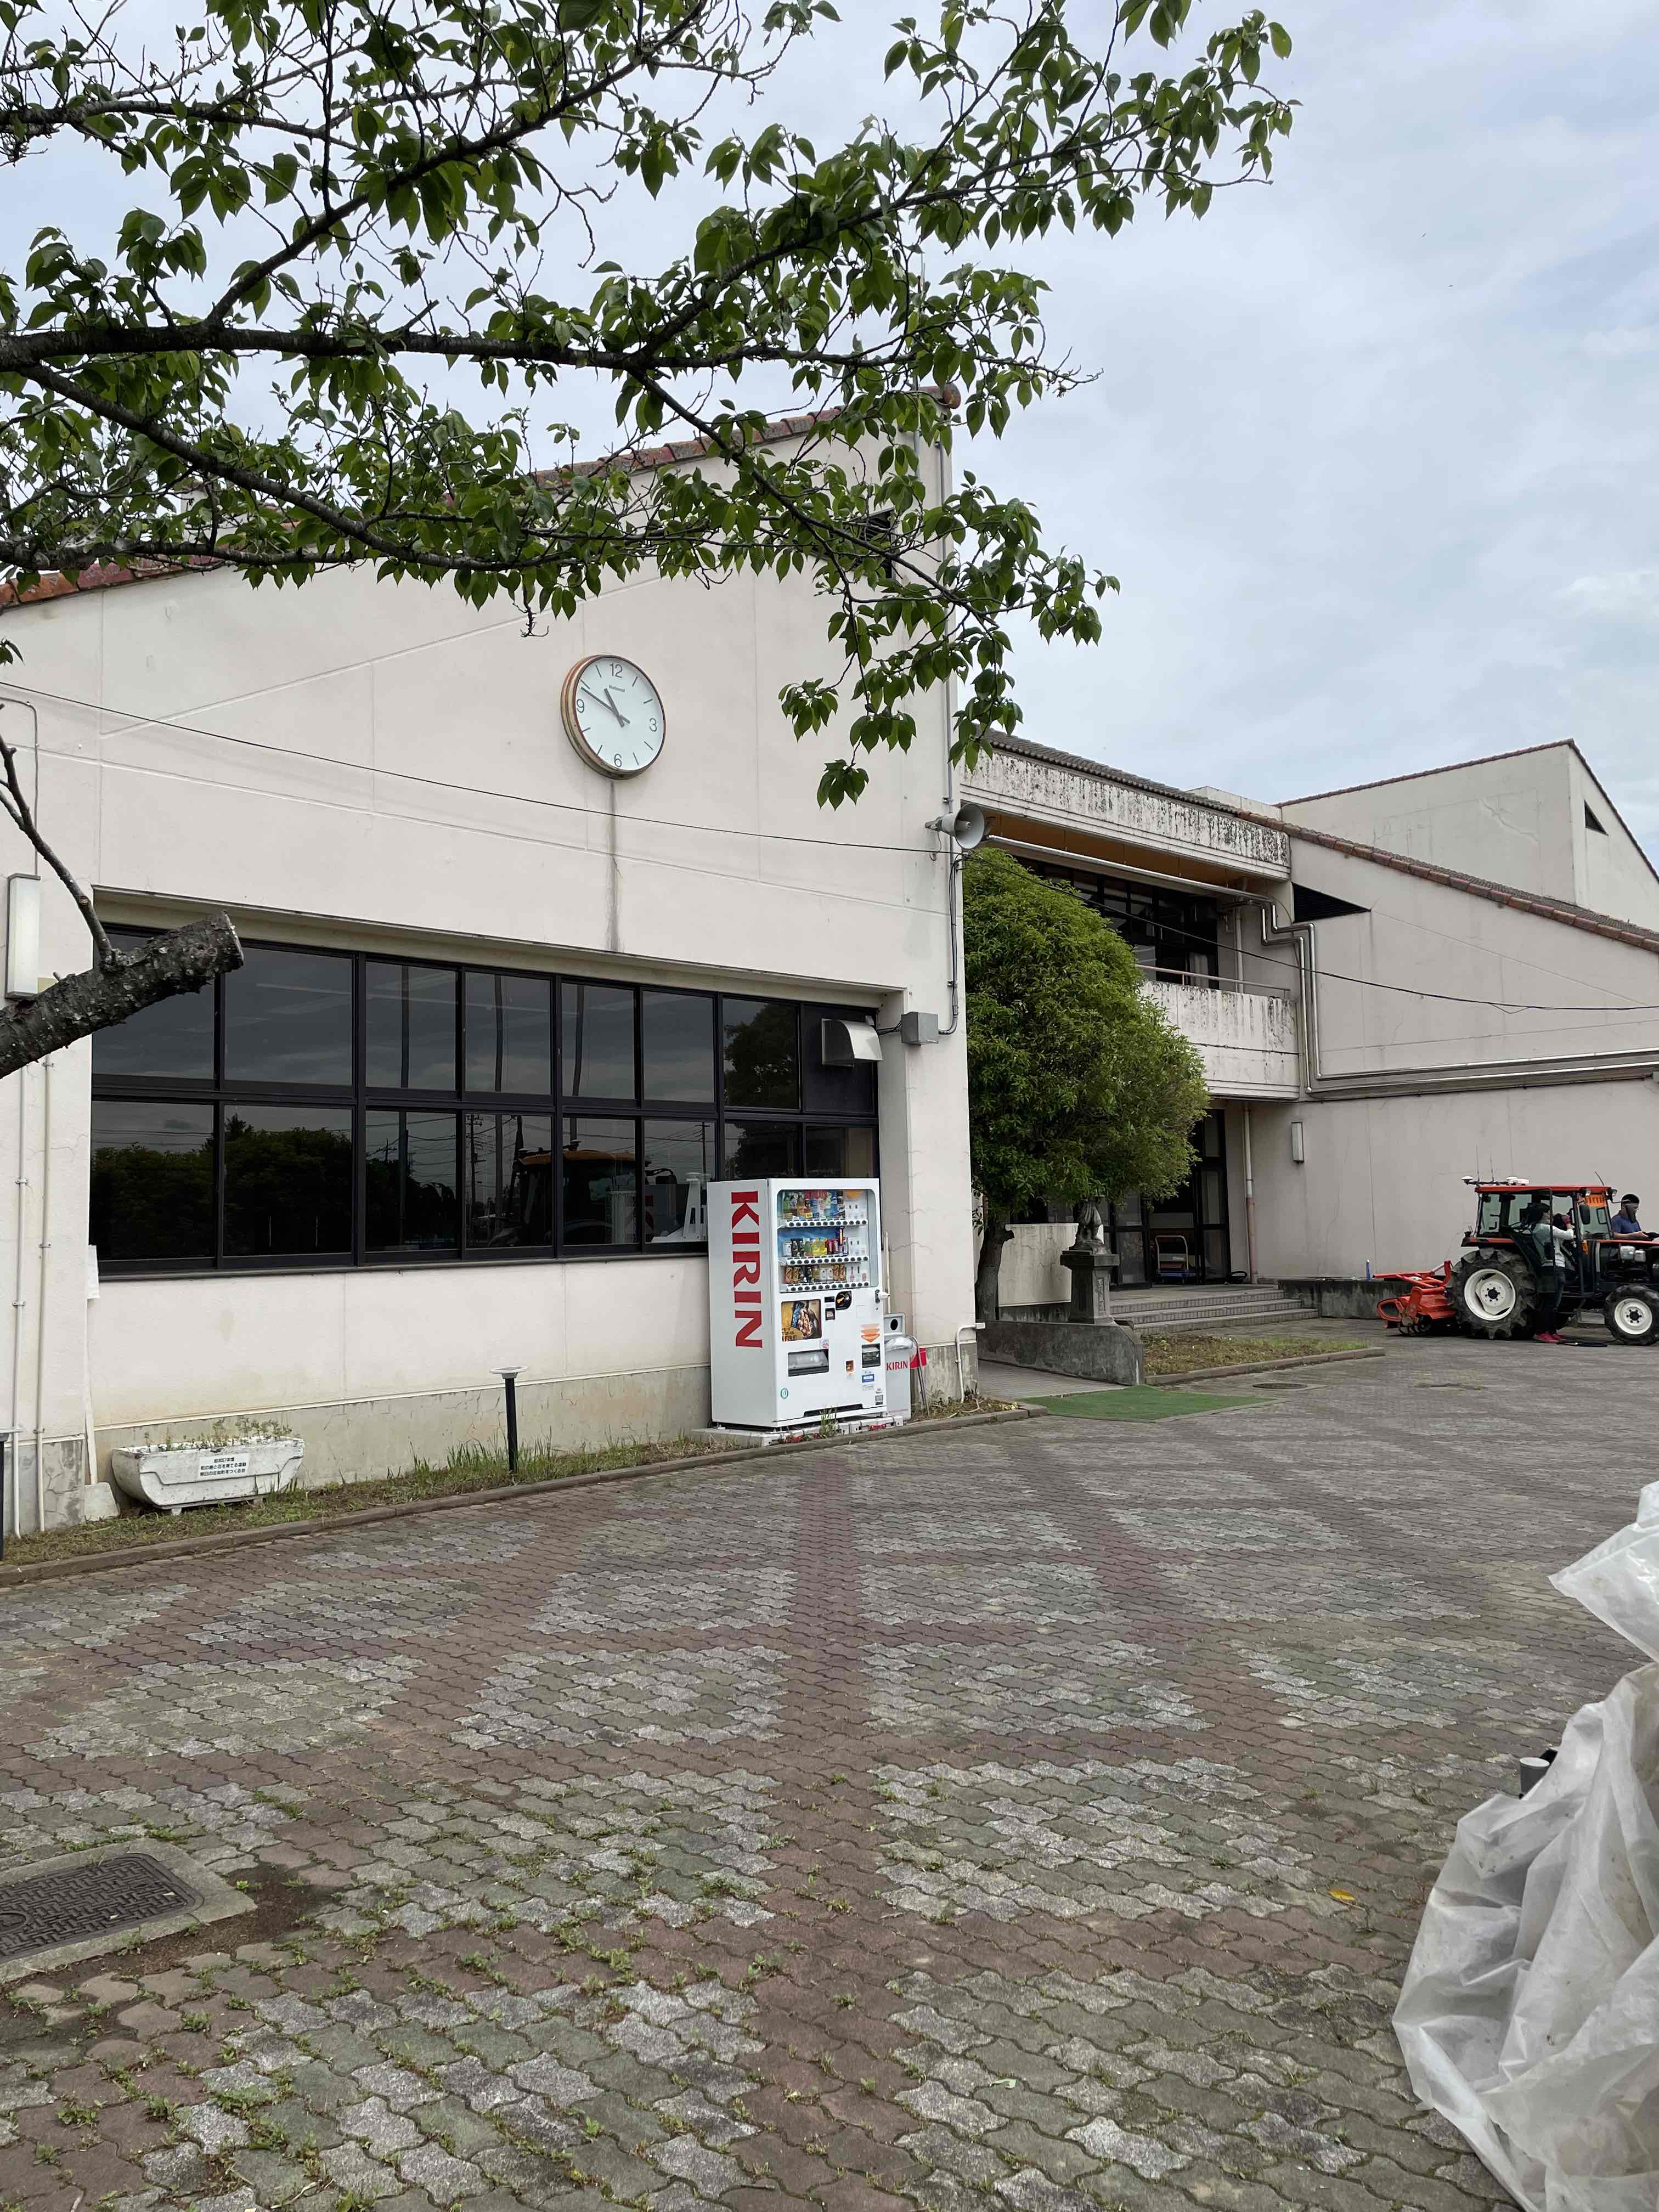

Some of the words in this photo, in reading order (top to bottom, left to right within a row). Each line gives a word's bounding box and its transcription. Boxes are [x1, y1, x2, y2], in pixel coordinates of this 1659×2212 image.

[610, 663, 623, 678] 12
[576, 699, 585, 713] 9
[649, 718, 658, 732] 3
[614, 753, 622, 768] 6
[731, 1190, 763, 1348] KIRIN
[887, 1361, 908, 1371] KIRIN
